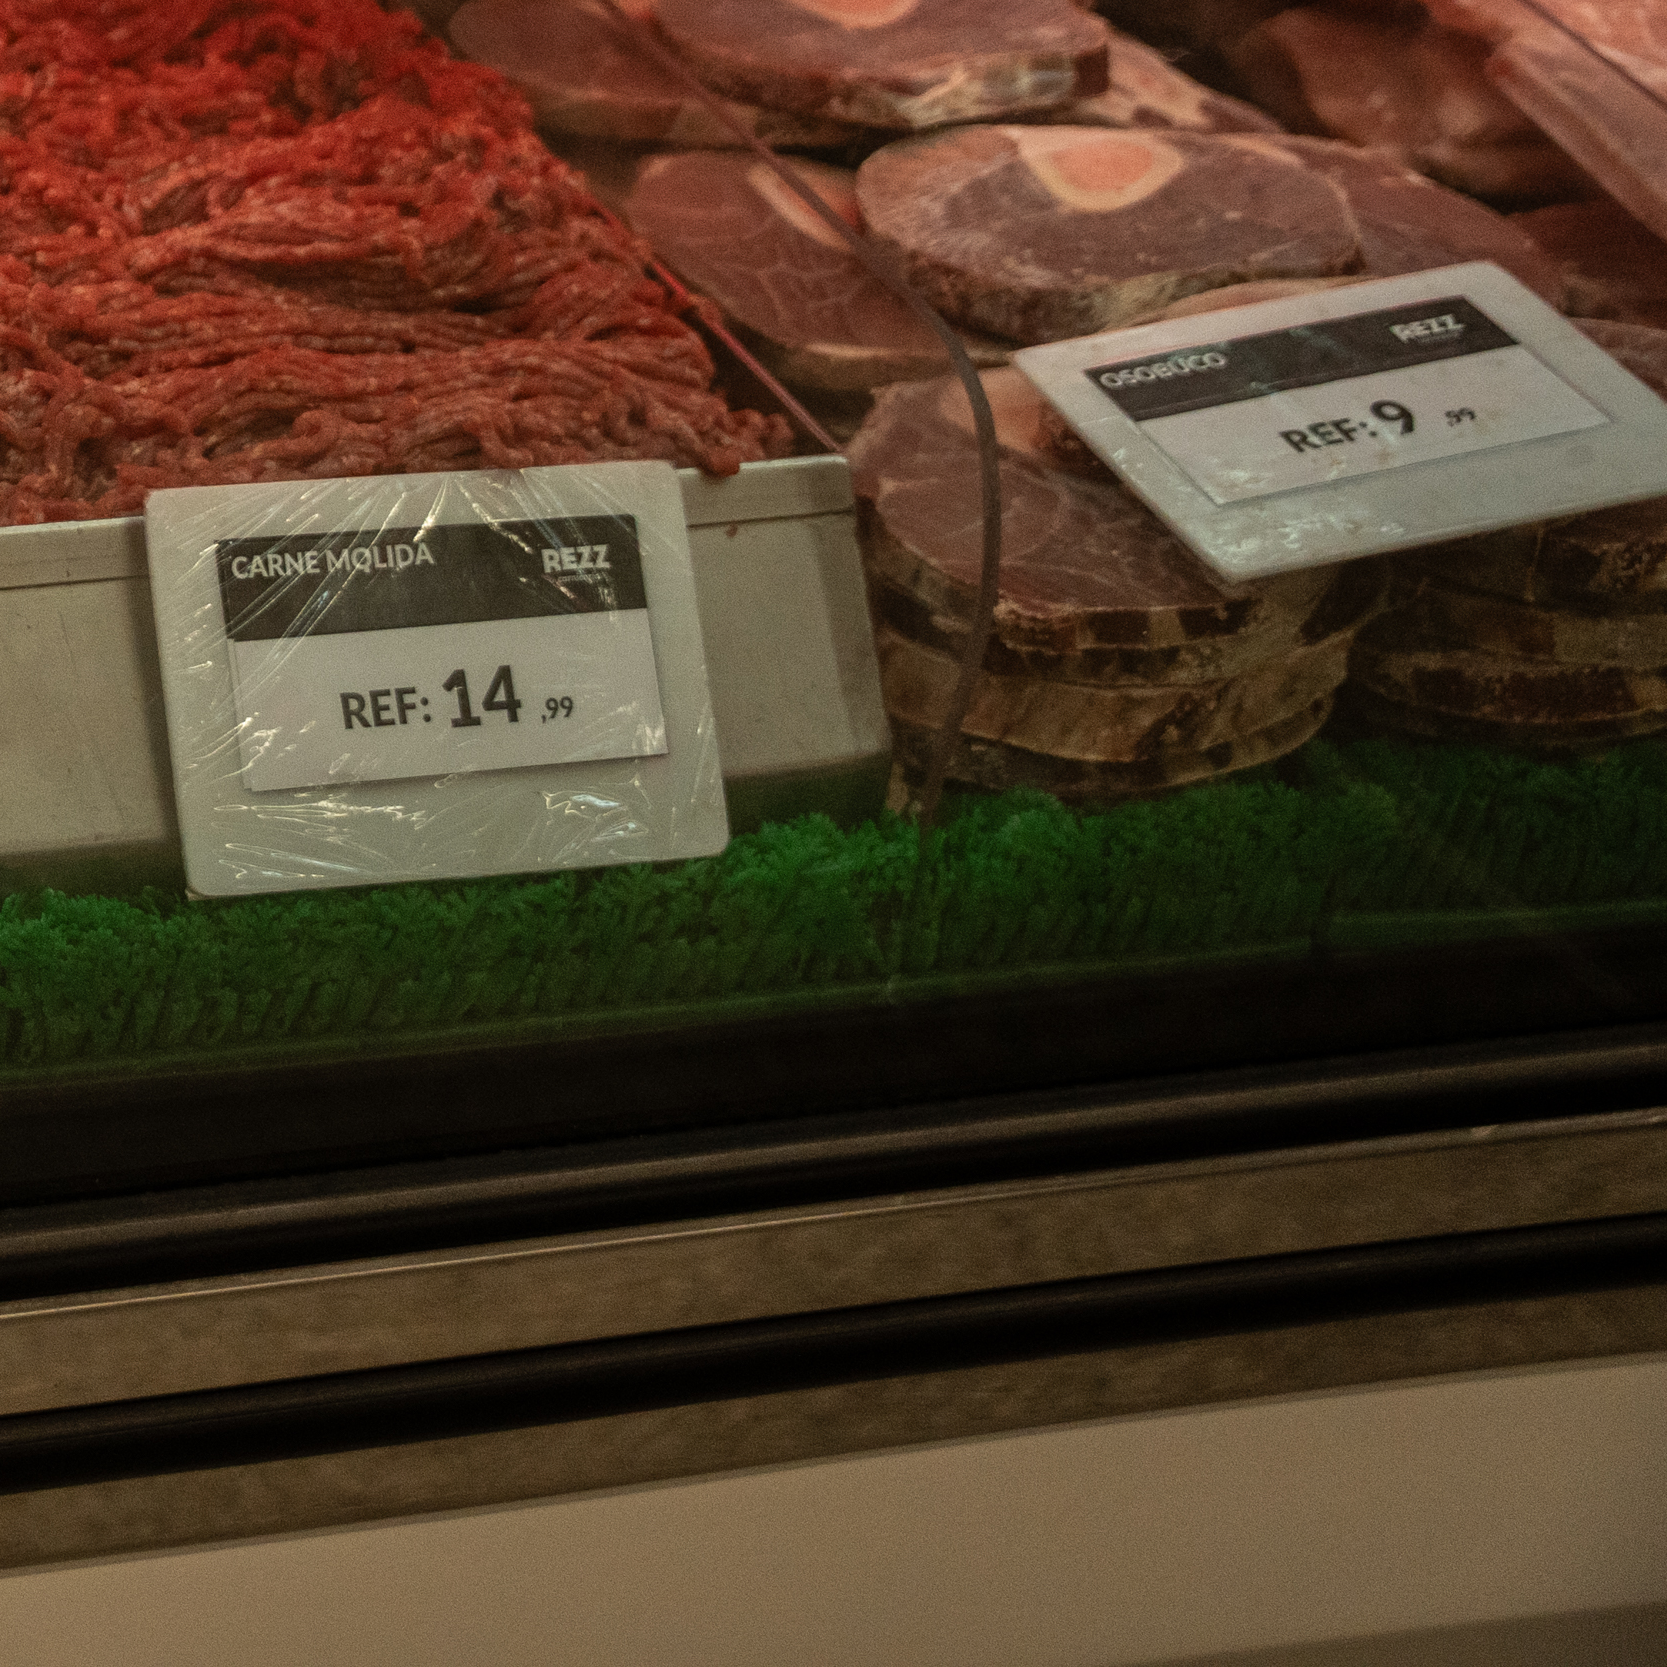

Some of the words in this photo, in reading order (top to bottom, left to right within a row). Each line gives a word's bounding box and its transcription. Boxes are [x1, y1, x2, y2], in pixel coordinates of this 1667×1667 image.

[1389, 313, 1466, 344] REZZ
[1278, 417, 1377, 453] REF:
[1370, 399, 1414, 435] 9
[231, 550, 320, 580] CARNE
[326, 541, 435, 574] MOLIDA
[541, 544, 612, 574] REZZ
[339, 686, 432, 730] REF:
[442, 665, 522, 728] 14
[541, 697, 574, 725] ,99
